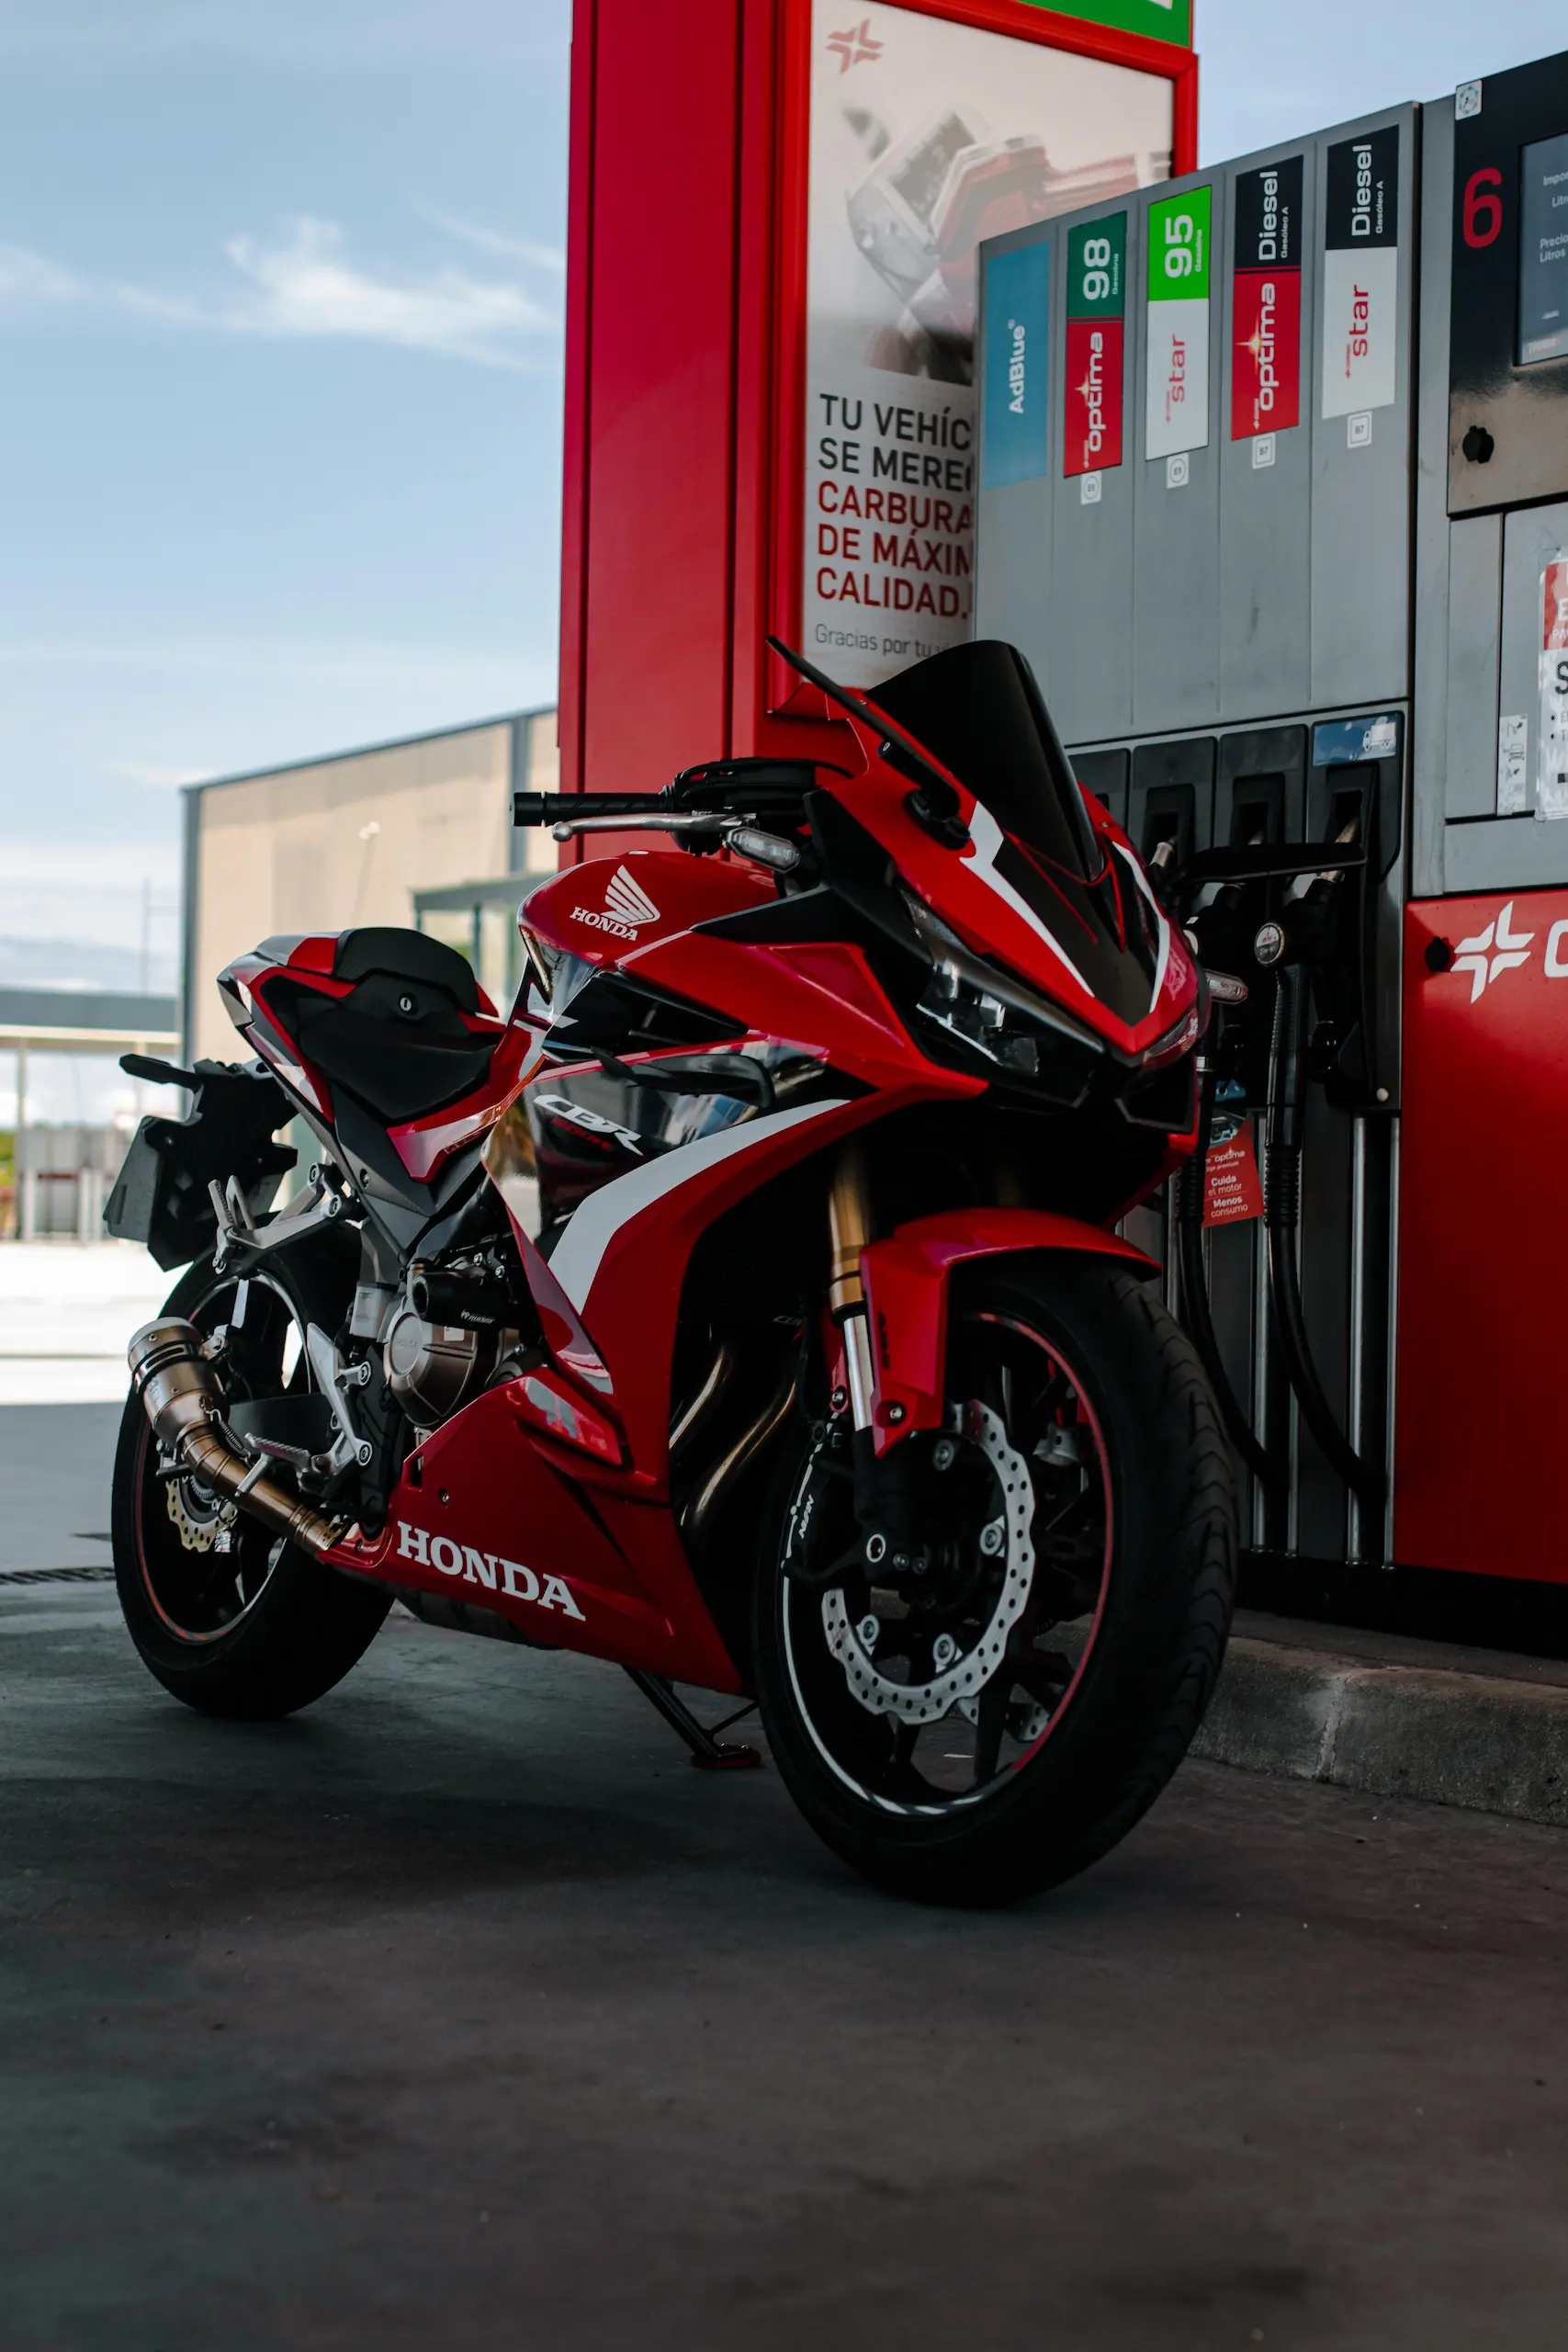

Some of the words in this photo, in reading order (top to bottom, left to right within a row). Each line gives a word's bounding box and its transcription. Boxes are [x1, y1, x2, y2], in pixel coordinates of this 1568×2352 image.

[1281, 207, 1290, 215] A
[1351, 144, 1372, 236] Diesel
[1376, 180, 1384, 189] A
[1462, 167, 1503, 248] 6
[1258, 171, 1279, 260] Diesel
[1083, 238, 1111, 300] 98
[1165, 215, 1194, 278] 95
[1258, 282, 1280, 411] optima
[1348, 284, 1370, 356] star
[1088, 332, 1107, 452] optima
[1168, 334, 1186, 402] star
[819, 393, 863, 432] TU
[818, 437, 861, 474] SE
[818, 523, 861, 560] DE
[817, 567, 969, 621] CALIDAD.
[815, 623, 878, 650] Gracias
[883, 638, 909, 656] por
[915, 639, 931, 658] tu
[570, 907, 638, 942] HONDA
[534, 1094, 644, 1157] CBR
[1208, 1187, 1216, 1196] el
[1218, 1183, 1242, 1194] motor
[1211, 1175, 1237, 1186] Cuida
[1213, 1196, 1243, 1208] Menos
[1211, 1204, 1248, 1218] consumo
[397, 1521, 587, 1623] HONDA
